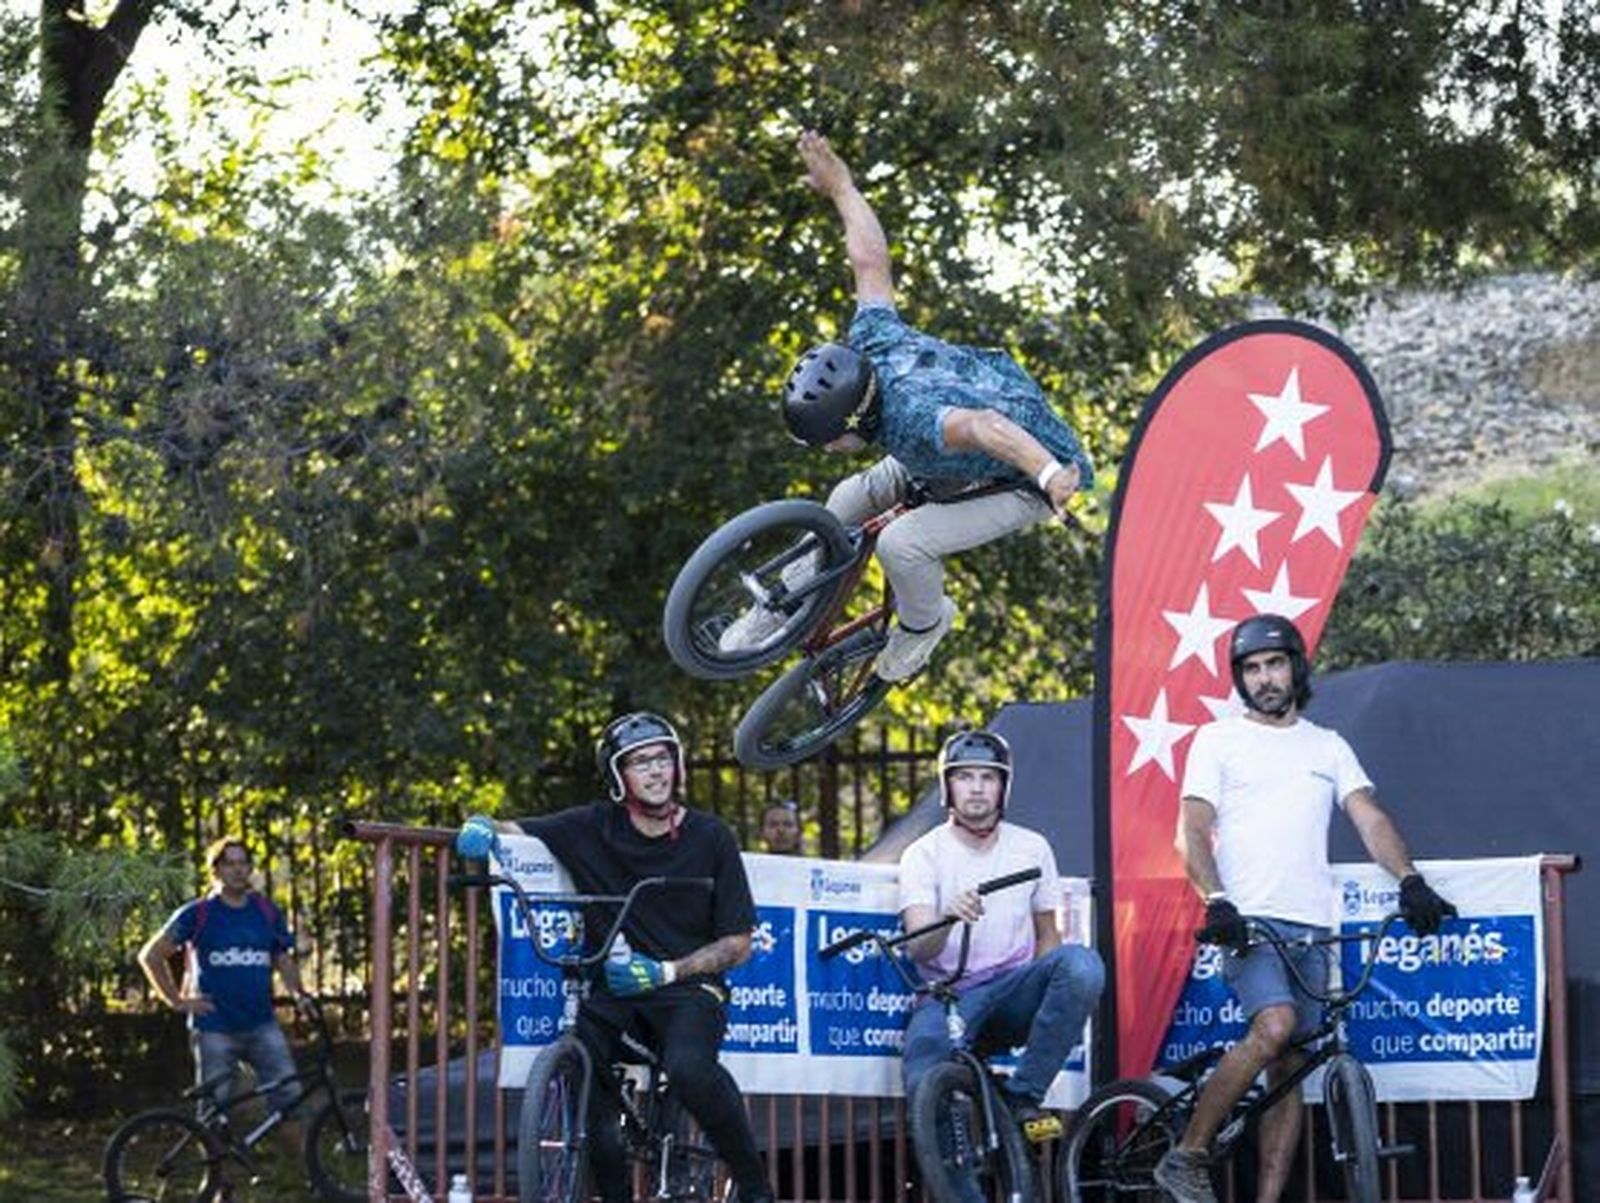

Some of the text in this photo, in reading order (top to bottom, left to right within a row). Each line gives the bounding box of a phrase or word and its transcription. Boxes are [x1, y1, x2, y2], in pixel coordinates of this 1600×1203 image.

[730, 983, 787, 1011] eporte
[1426, 992, 1520, 1023] deporte
[516, 1014, 554, 1041] que
[827, 1025, 861, 1051] que
[1371, 1025, 1535, 1059] que compartir
